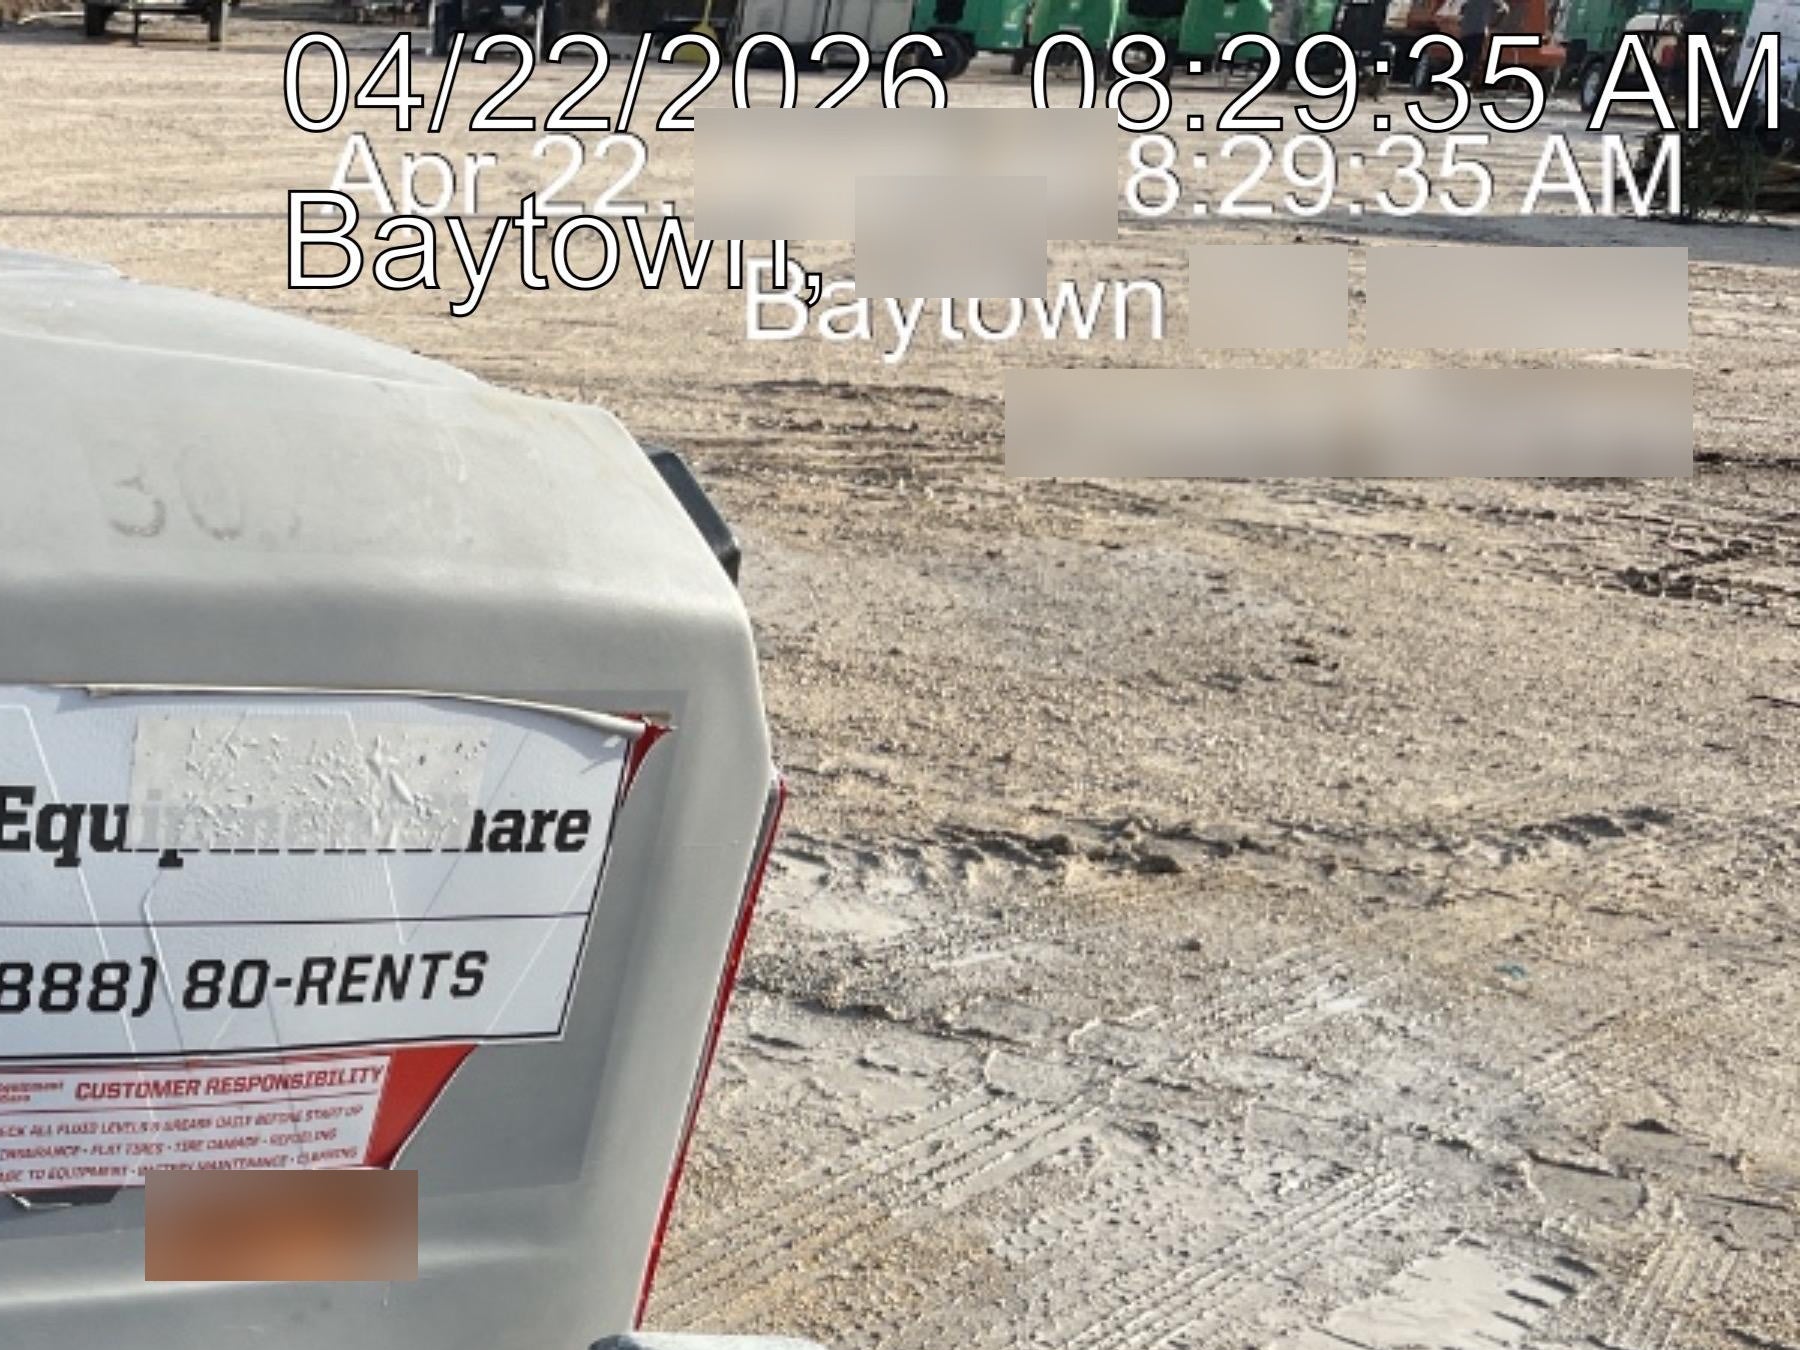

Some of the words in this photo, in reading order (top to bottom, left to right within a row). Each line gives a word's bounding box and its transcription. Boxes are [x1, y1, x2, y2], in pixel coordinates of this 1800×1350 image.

[183, 951, 489, 1010] 80-RENTS
[75, 1078, 201, 1101] CUSTOMER
[204, 1065, 385, 1097] RESPONSIBILITY
